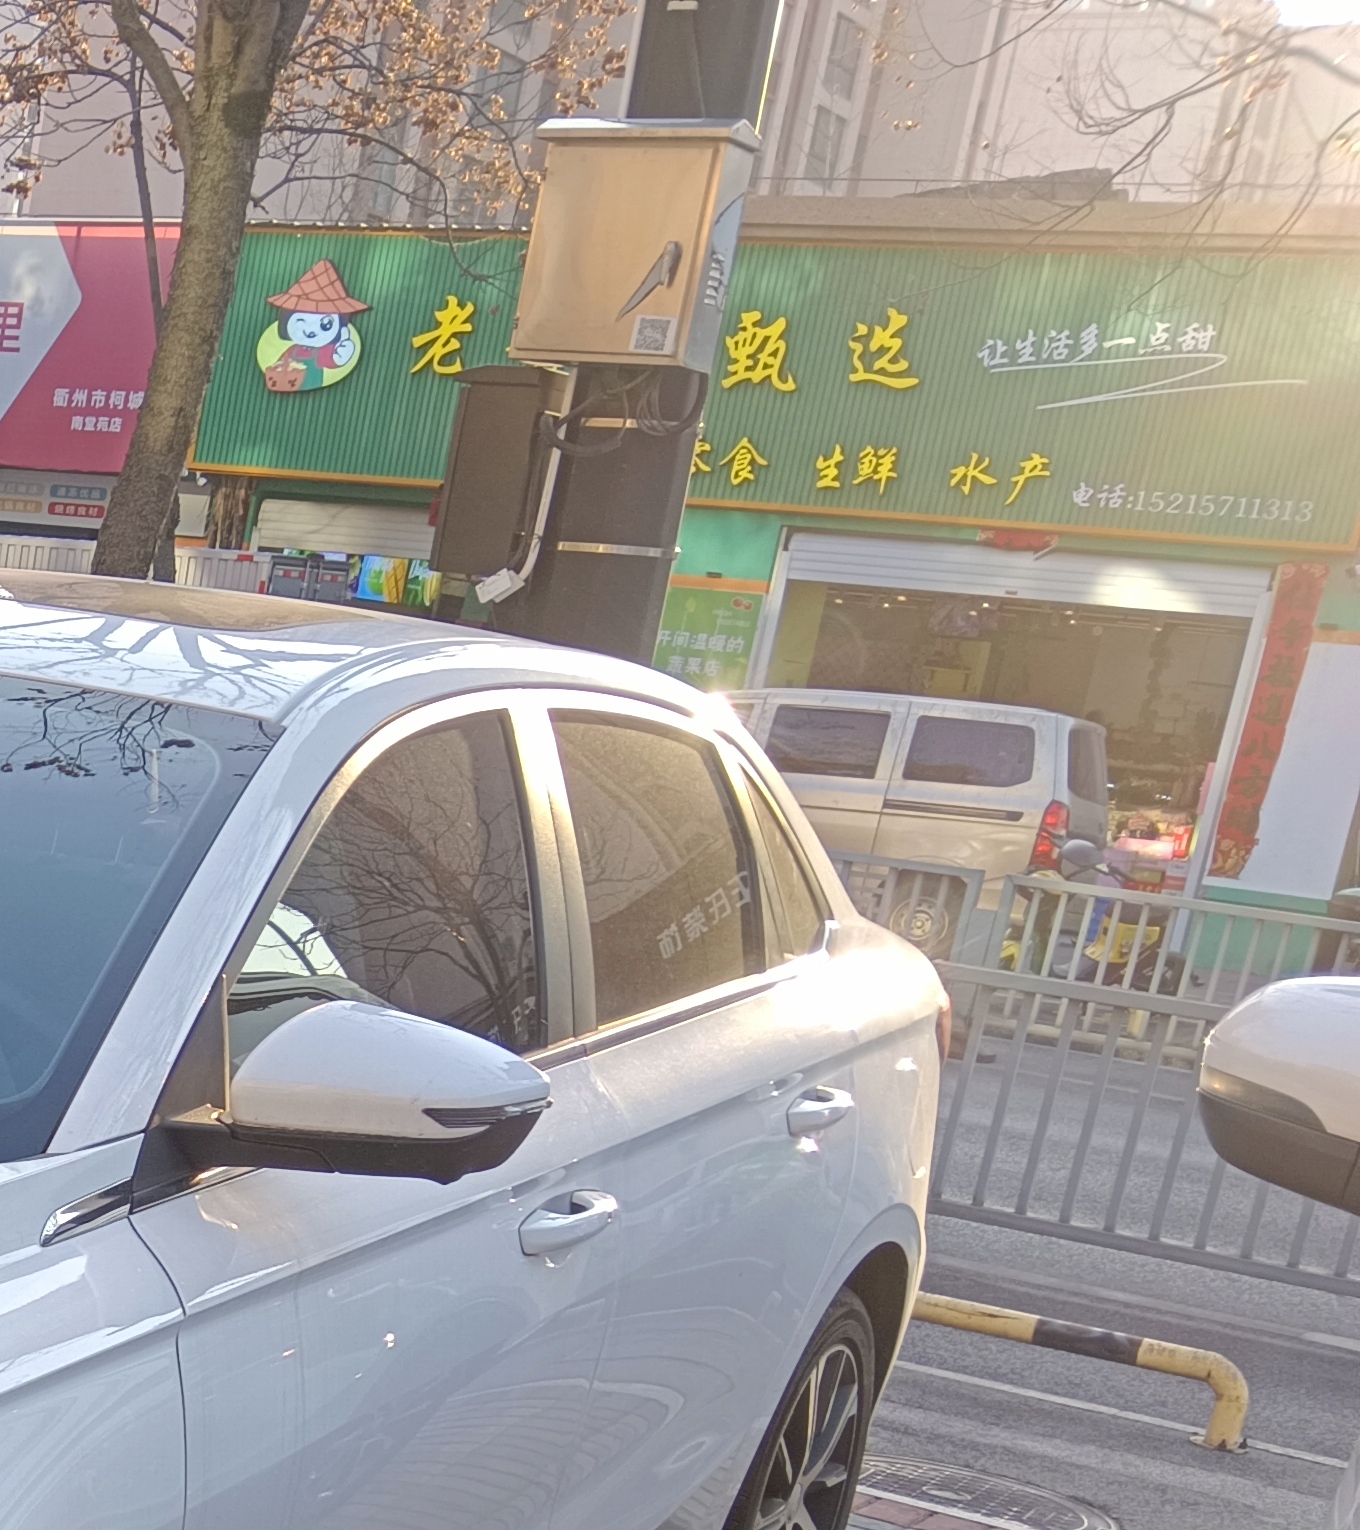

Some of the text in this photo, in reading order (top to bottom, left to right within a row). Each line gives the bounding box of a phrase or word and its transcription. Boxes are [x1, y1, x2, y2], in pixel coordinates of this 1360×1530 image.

[411, 296, 920, 393] 老 甄选
[977, 323, 1217, 367] 让生活多一点甜
[815, 443, 899, 494] 生鲜
[949, 452, 1052, 505] 水产
[1073, 482, 1314, 523] 电话:15215711313
